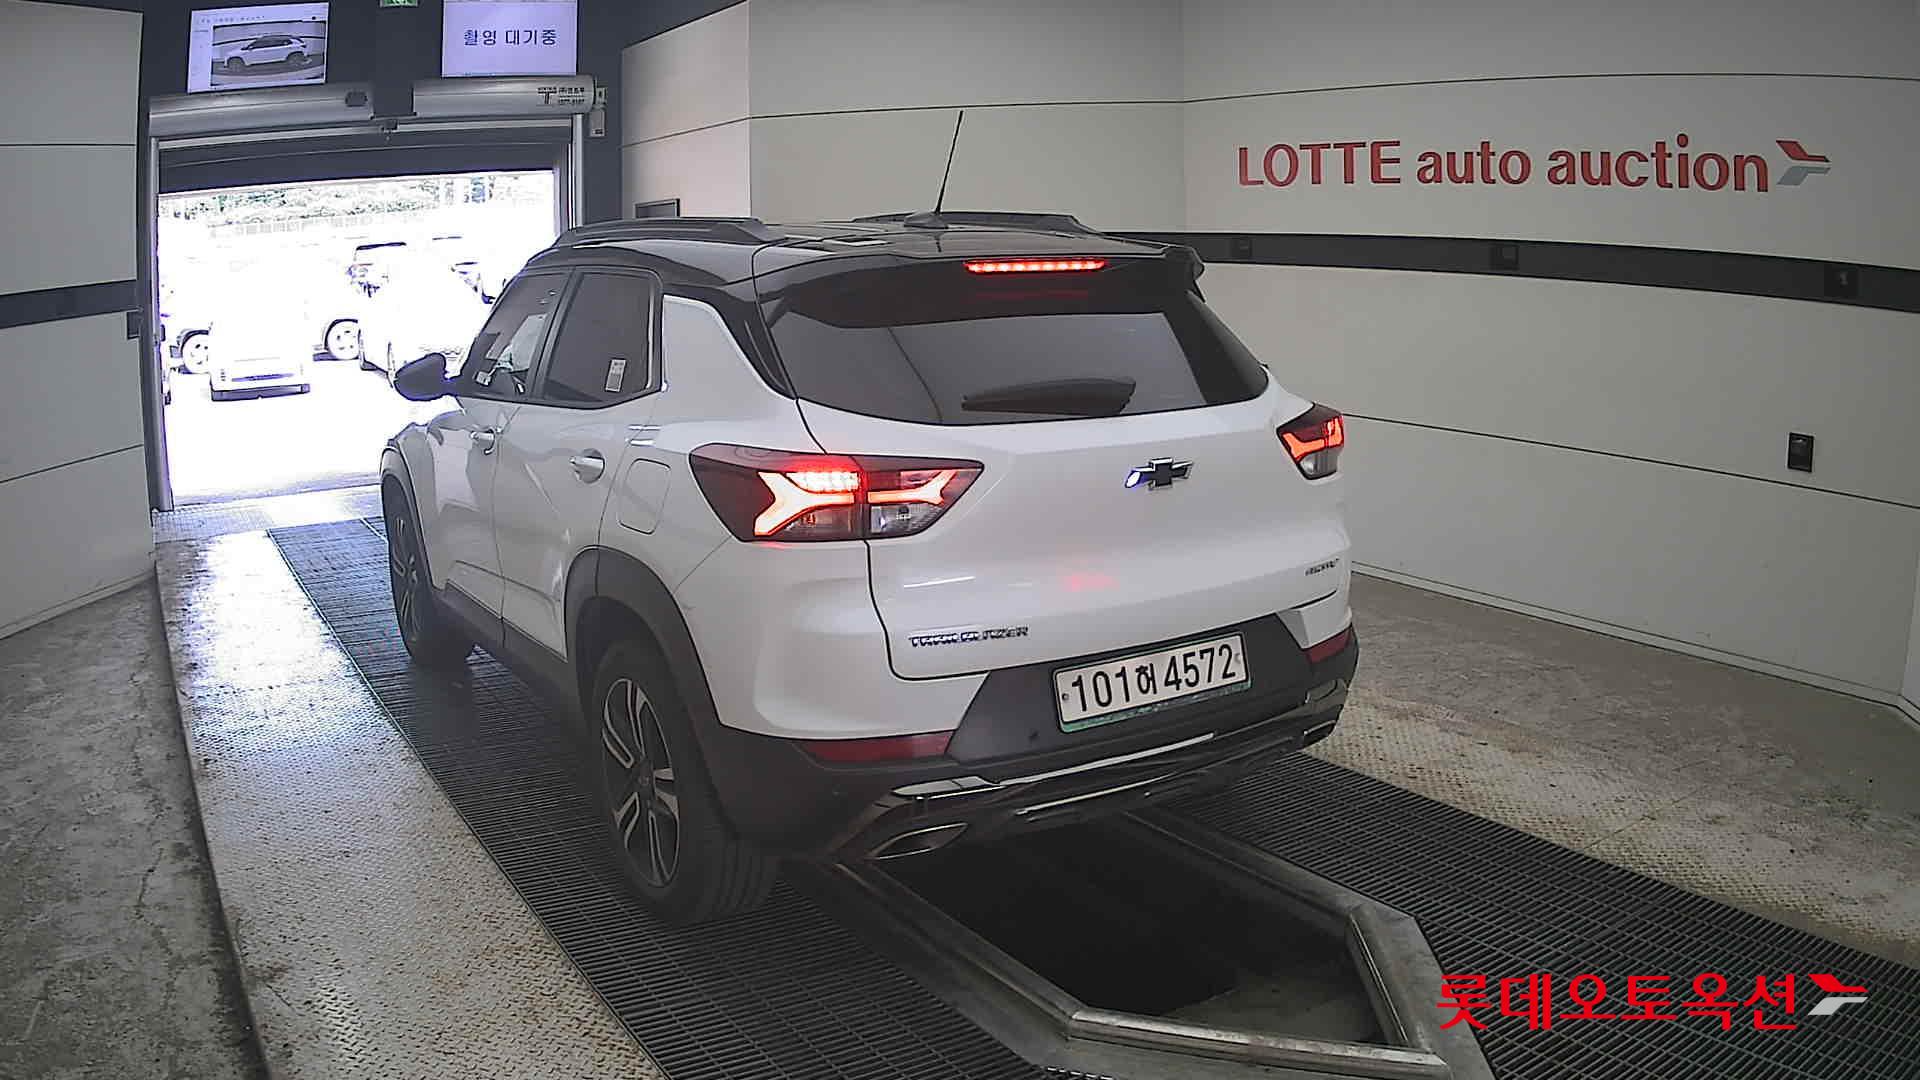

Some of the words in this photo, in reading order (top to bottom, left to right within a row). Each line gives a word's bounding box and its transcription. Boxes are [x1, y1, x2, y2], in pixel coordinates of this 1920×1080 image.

[505, 29, 557, 46] 대기중
[1238, 140, 1401, 187] LOTTE
[1416, 140, 1532, 185] auto
[1547, 133, 1769, 192] auction
[1164, 643, 1236, 691] 4572
